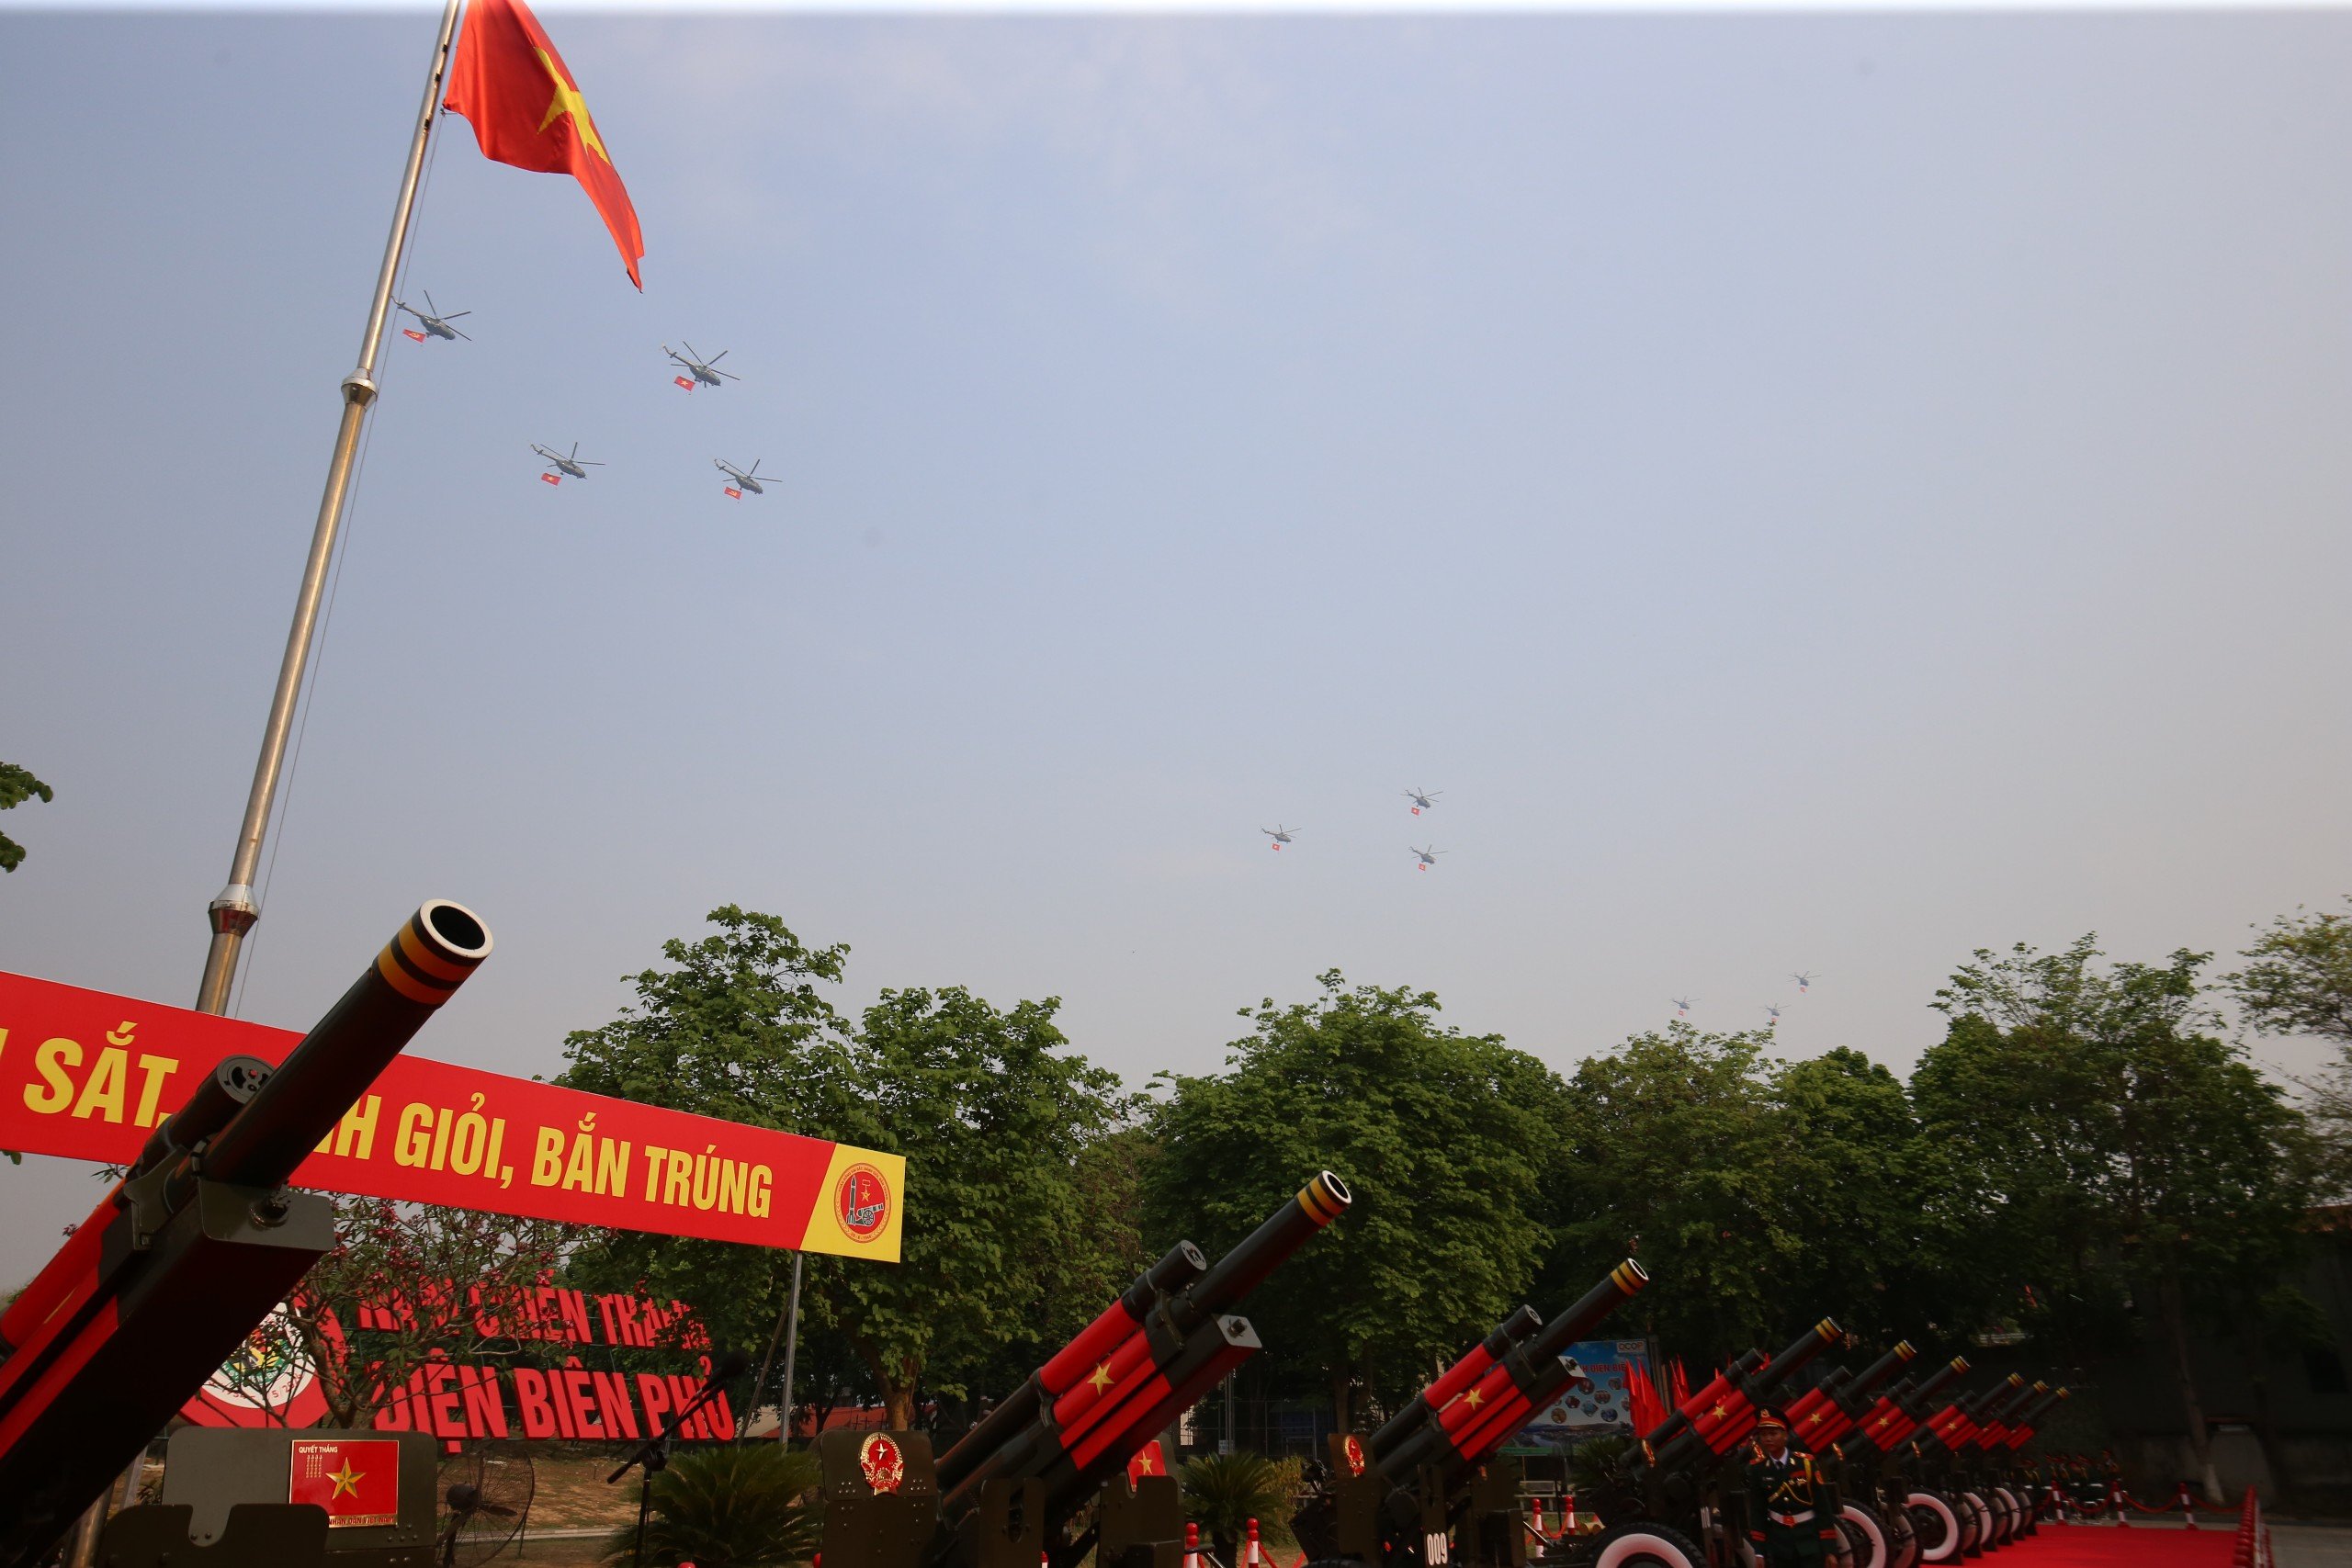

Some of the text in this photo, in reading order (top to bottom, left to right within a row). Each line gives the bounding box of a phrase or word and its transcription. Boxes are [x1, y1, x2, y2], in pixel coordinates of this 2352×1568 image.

[393, 1091, 514, 1190] GIỎI,
[530, 1111, 632, 1198] BẮN
[644, 1144, 773, 1219] TRÚNG
[513, 1355, 640, 1439] BIÊN
[636, 1355, 735, 1441] PHỦ
[299, 1444, 318, 1454] QUYẾT
[1427, 1531, 1448, 1566] 009
